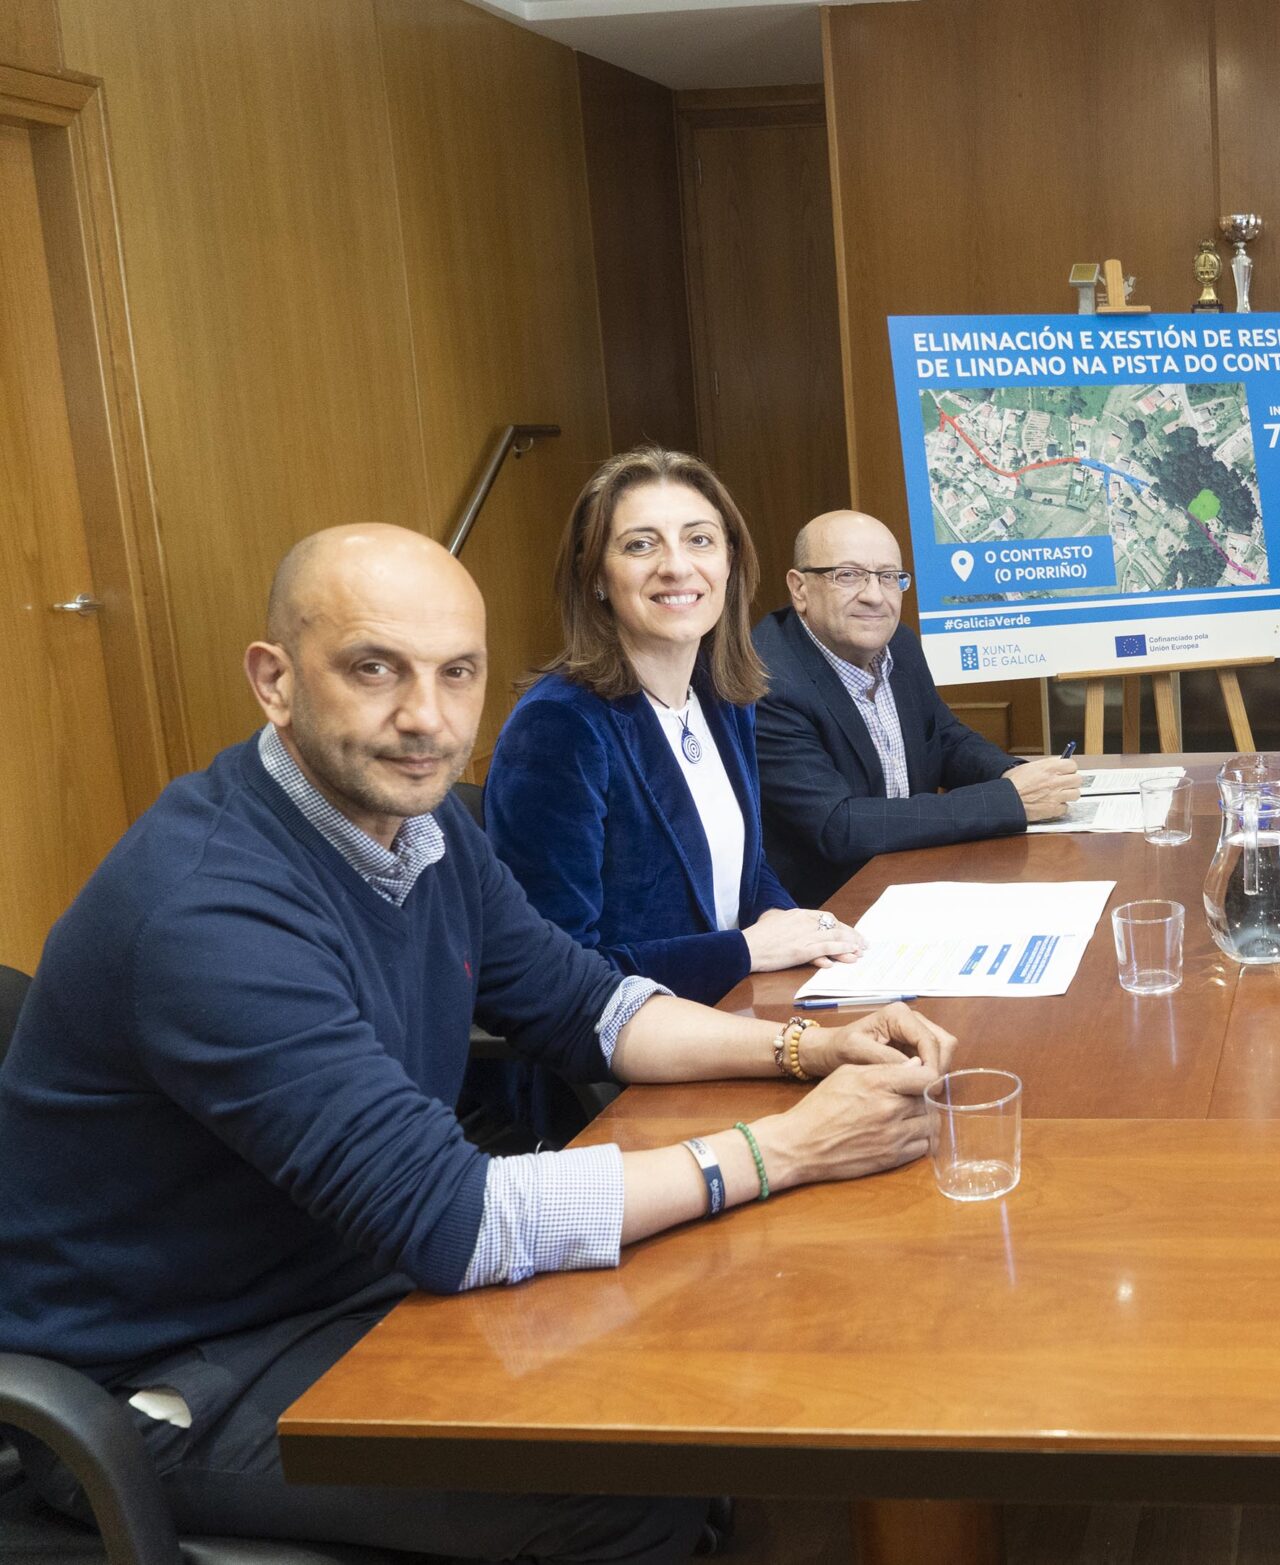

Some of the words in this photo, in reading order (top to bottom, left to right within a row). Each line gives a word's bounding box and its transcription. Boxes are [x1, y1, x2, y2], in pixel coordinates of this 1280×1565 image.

[913, 325, 1074, 352] ELIMINACIÓN
[1080, 331, 1094, 350] E
[1098, 324, 1197, 349] XESTIÓN
[1203, 329, 1232, 348] DE
[917, 358, 950, 378] DE
[956, 356, 1066, 377] LINDANO
[1072, 356, 1107, 375] NA
[1112, 355, 1180, 374] PISTA
[1184, 354, 1217, 373] DO
[984, 550, 997, 564] O
[1000, 545, 1093, 563] CONTRASTO
[995, 568, 1012, 584] (O
[1015, 562, 1087, 580] PORRIÑO)
[944, 614, 1031, 630] #GaliciaVerde
[1149, 634, 1193, 643] Cofinanciado
[1194, 633, 1209, 642] pola
[983, 644, 1021, 655] XUNTA
[1171, 643, 1199, 652] Europea
[983, 657, 998, 667] DE
[1001, 653, 1047, 666] GALICIA
